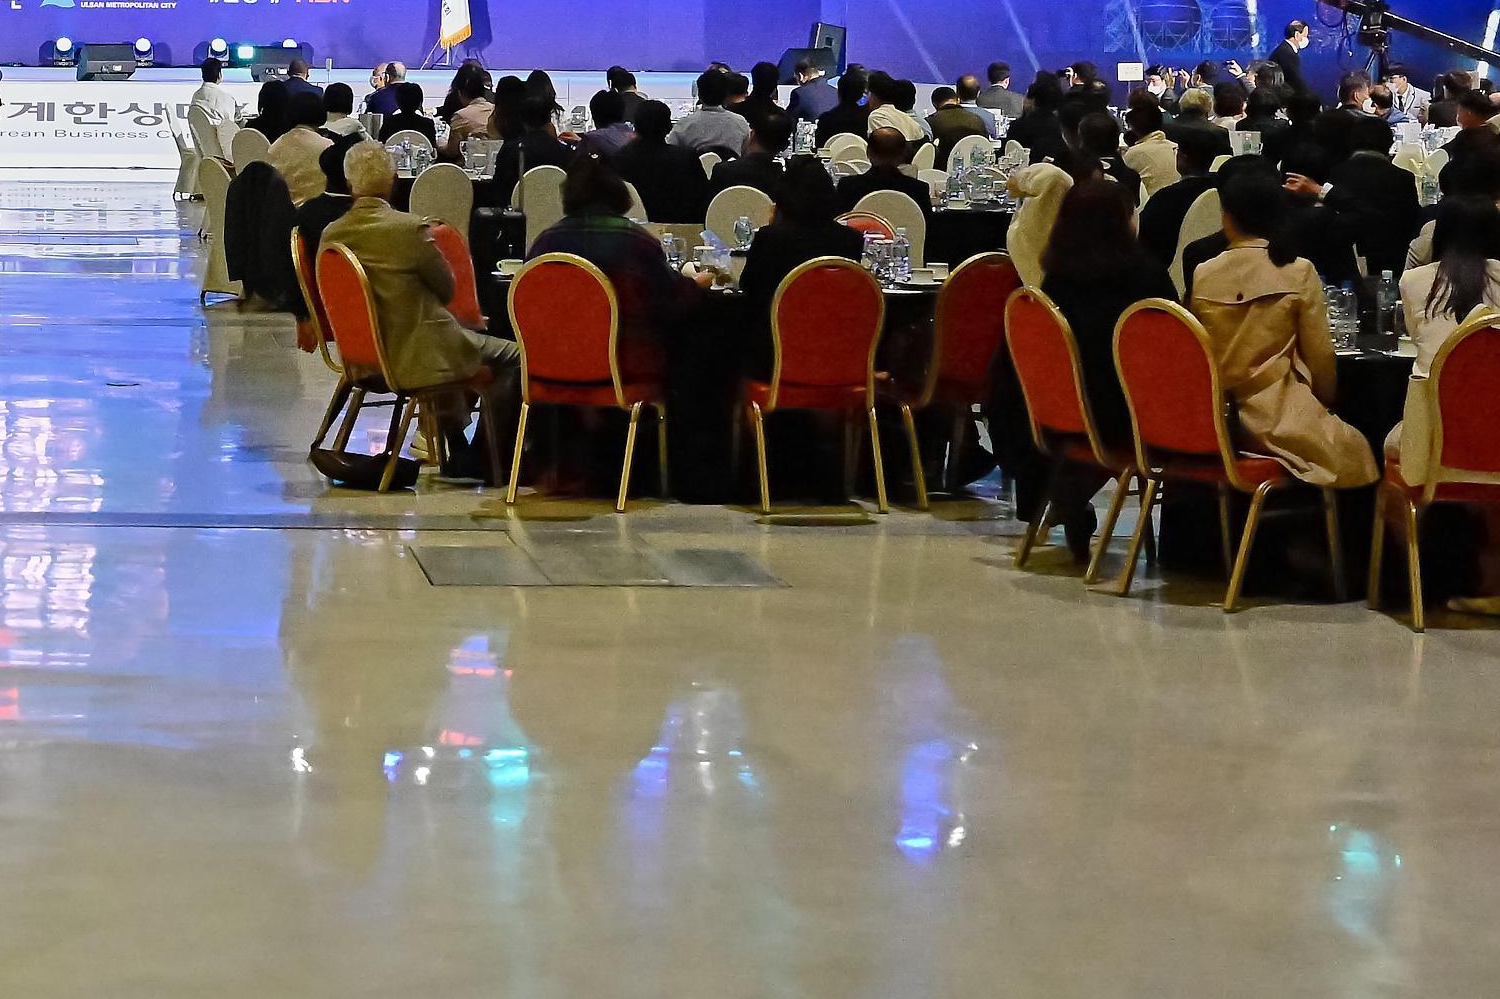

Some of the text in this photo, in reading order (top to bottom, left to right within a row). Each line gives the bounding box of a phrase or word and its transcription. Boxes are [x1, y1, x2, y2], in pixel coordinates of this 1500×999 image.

[105, 1, 159, 9] METROPOLITAN
[160, 1, 177, 9] CITY
[54, 130, 148, 139] Business
